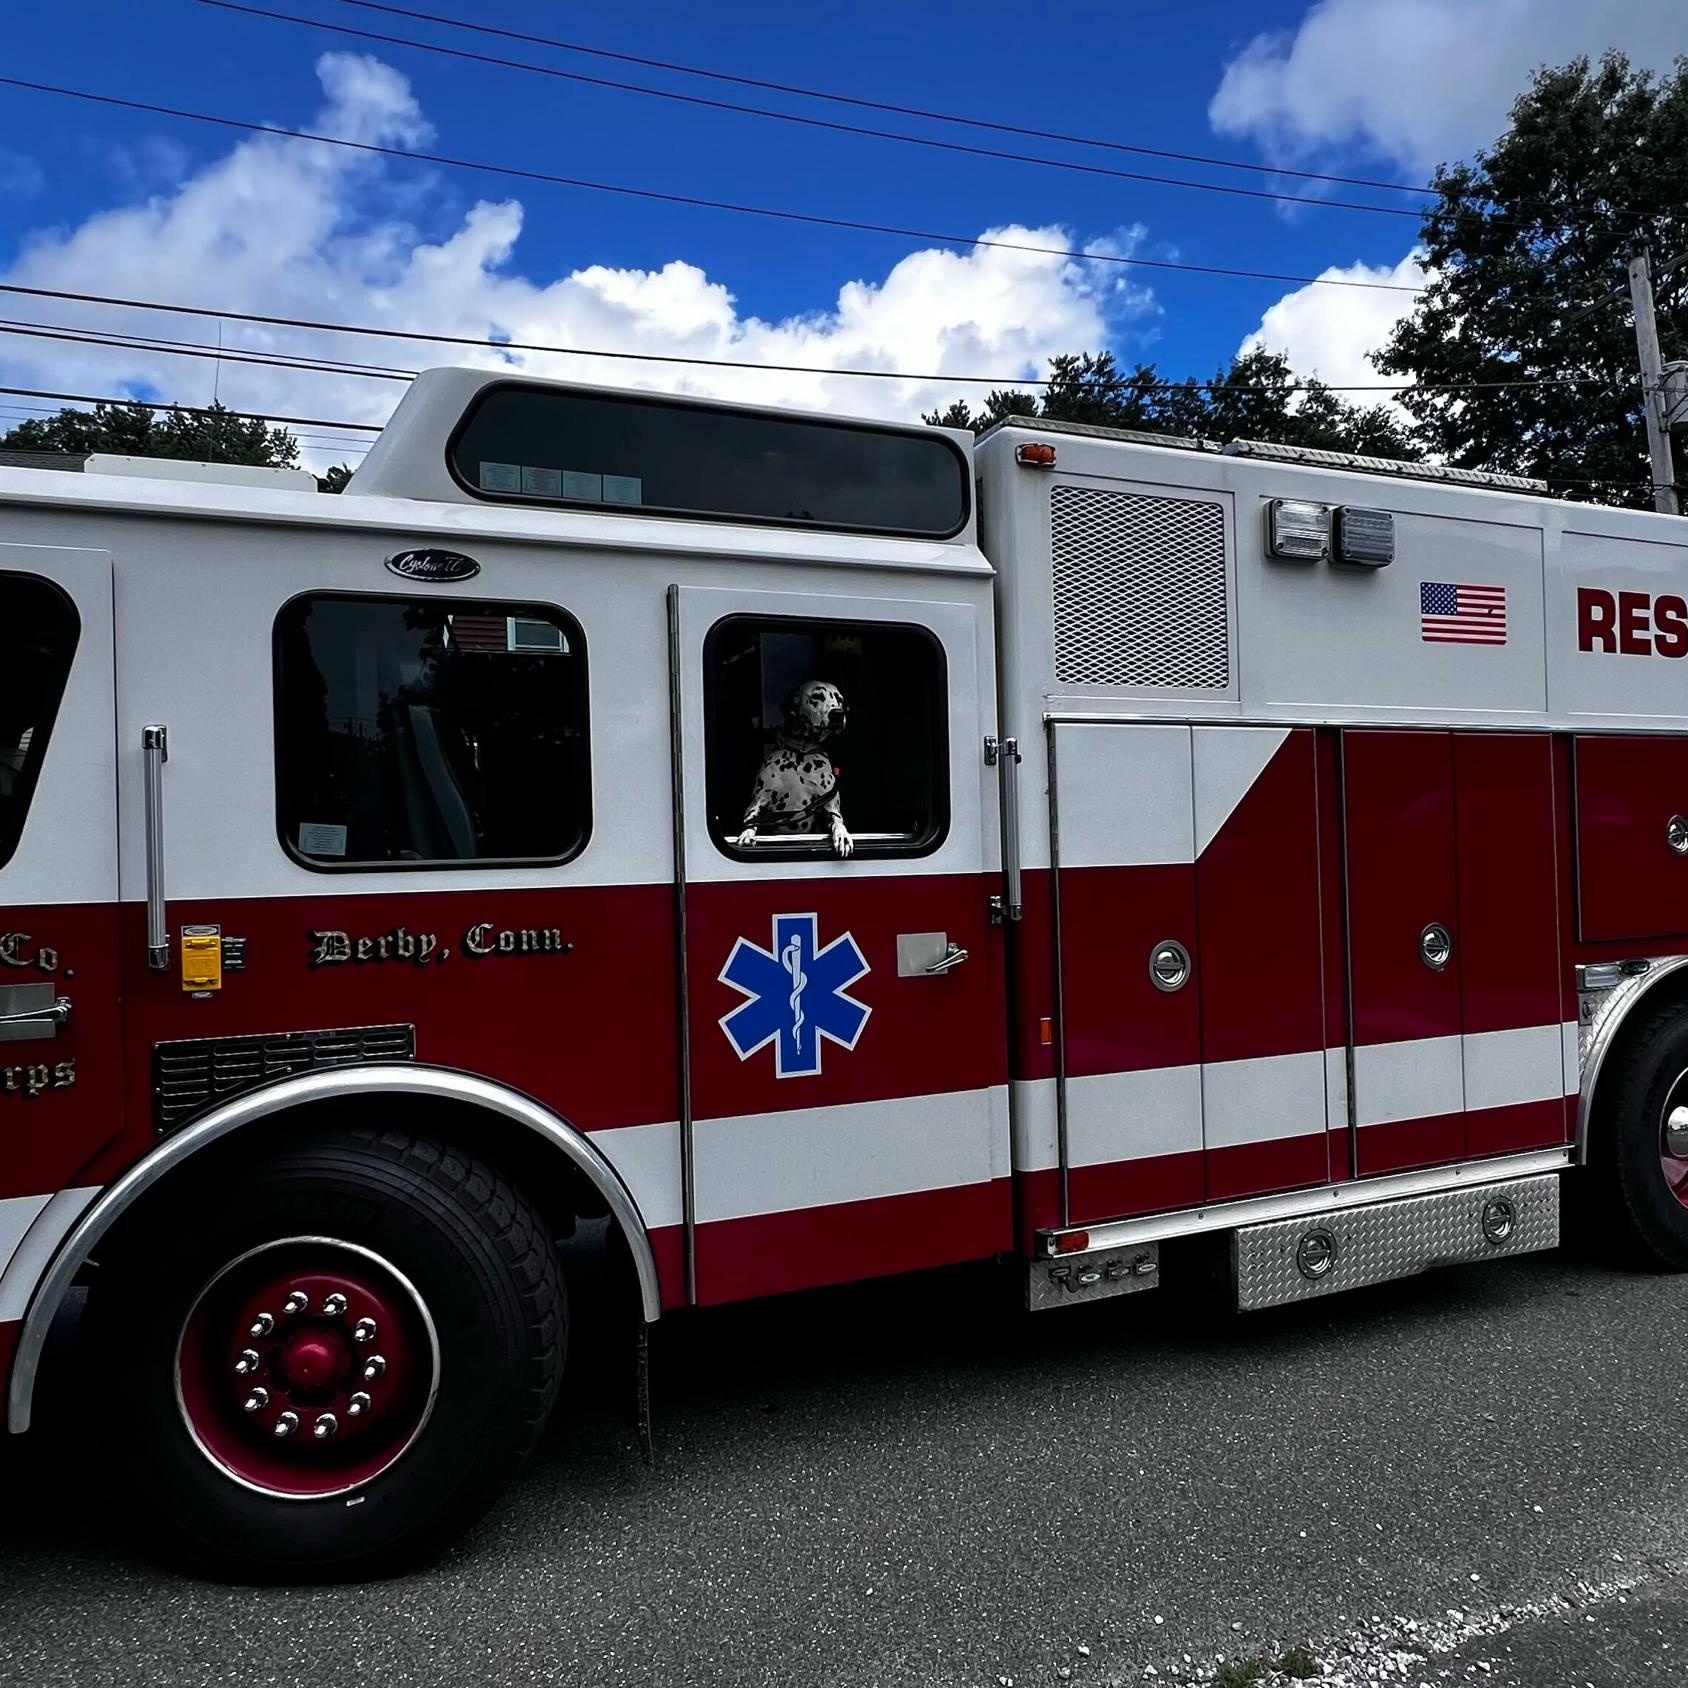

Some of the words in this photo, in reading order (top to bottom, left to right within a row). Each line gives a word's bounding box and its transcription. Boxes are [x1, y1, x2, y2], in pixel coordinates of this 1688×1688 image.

[1577, 587, 1688, 659] RES
[0, 932, 75, 976] Co.
[313, 926, 450, 964] Derby,
[466, 922, 574, 954] Conn.
[3, 1057, 76, 1096] rps
